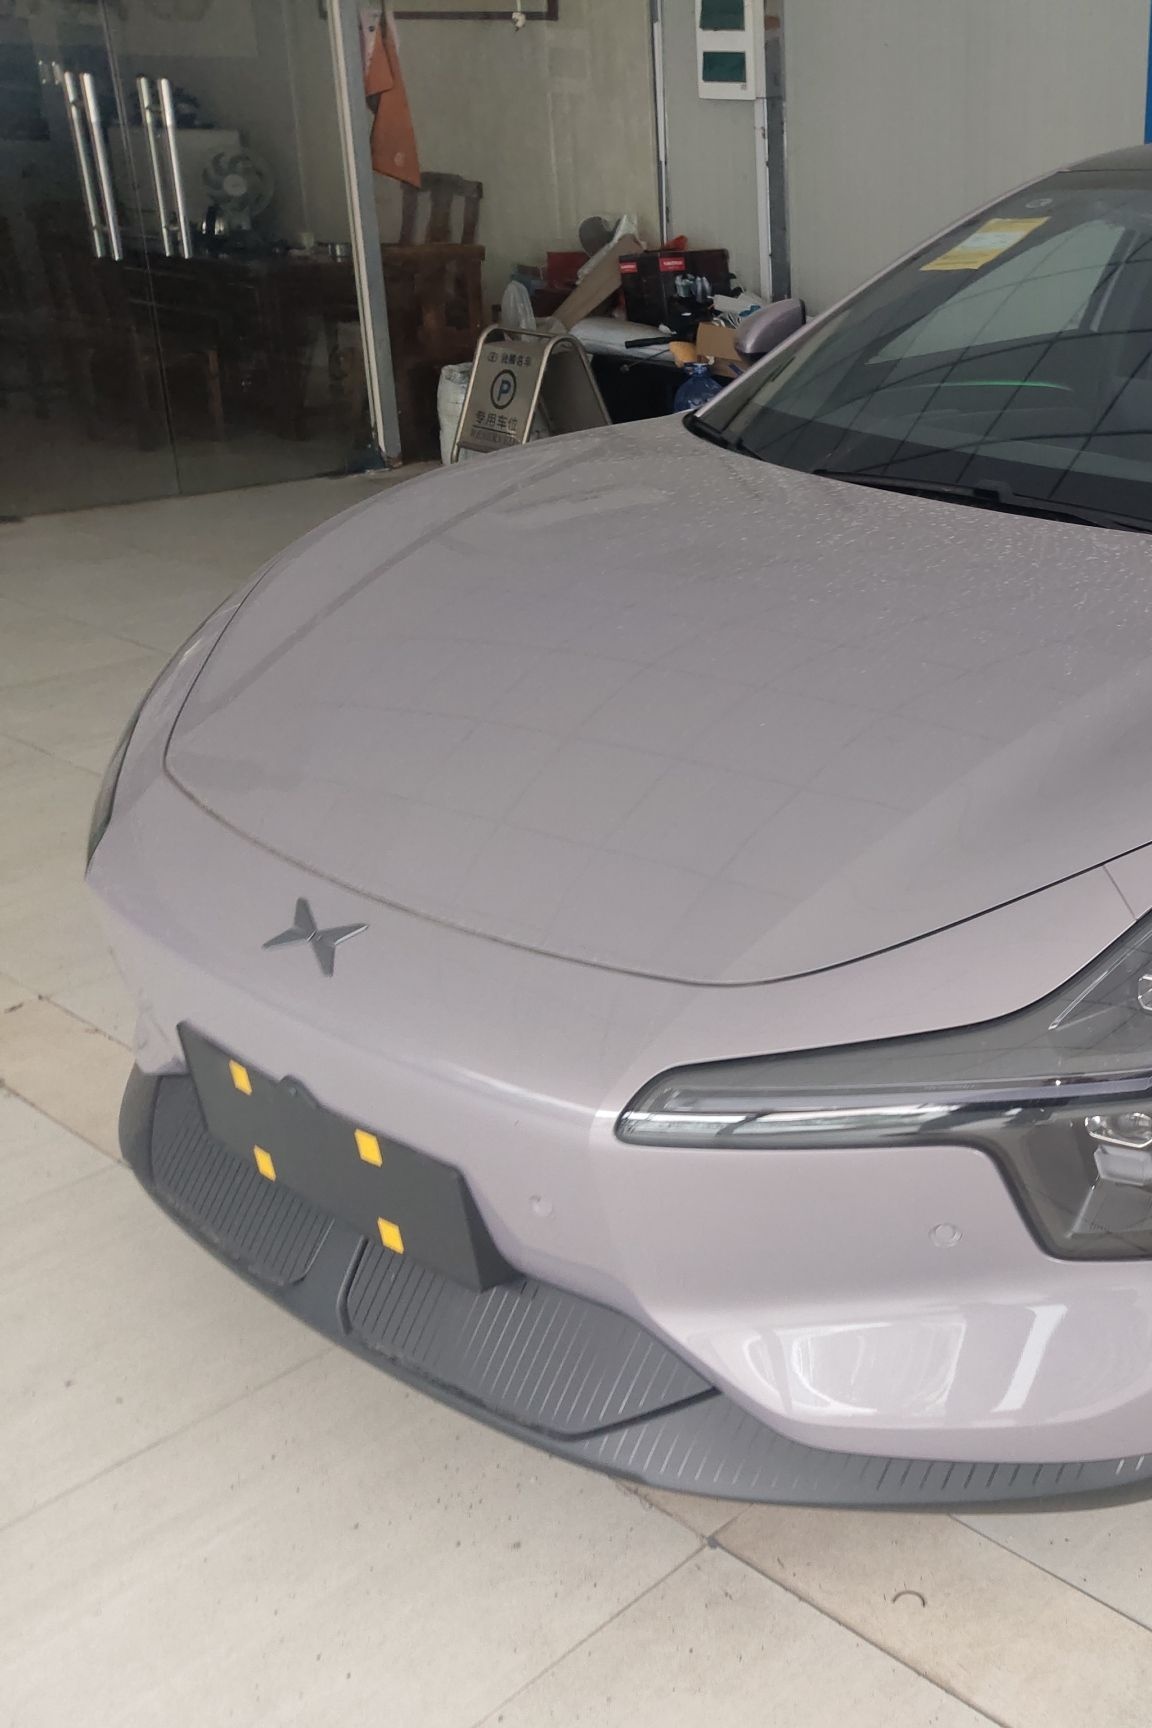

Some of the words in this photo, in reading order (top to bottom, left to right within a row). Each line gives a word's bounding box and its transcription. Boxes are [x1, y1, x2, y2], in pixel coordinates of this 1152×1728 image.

[497, 379, 511, 401] P
[475, 410, 518, 431] 专用车位
